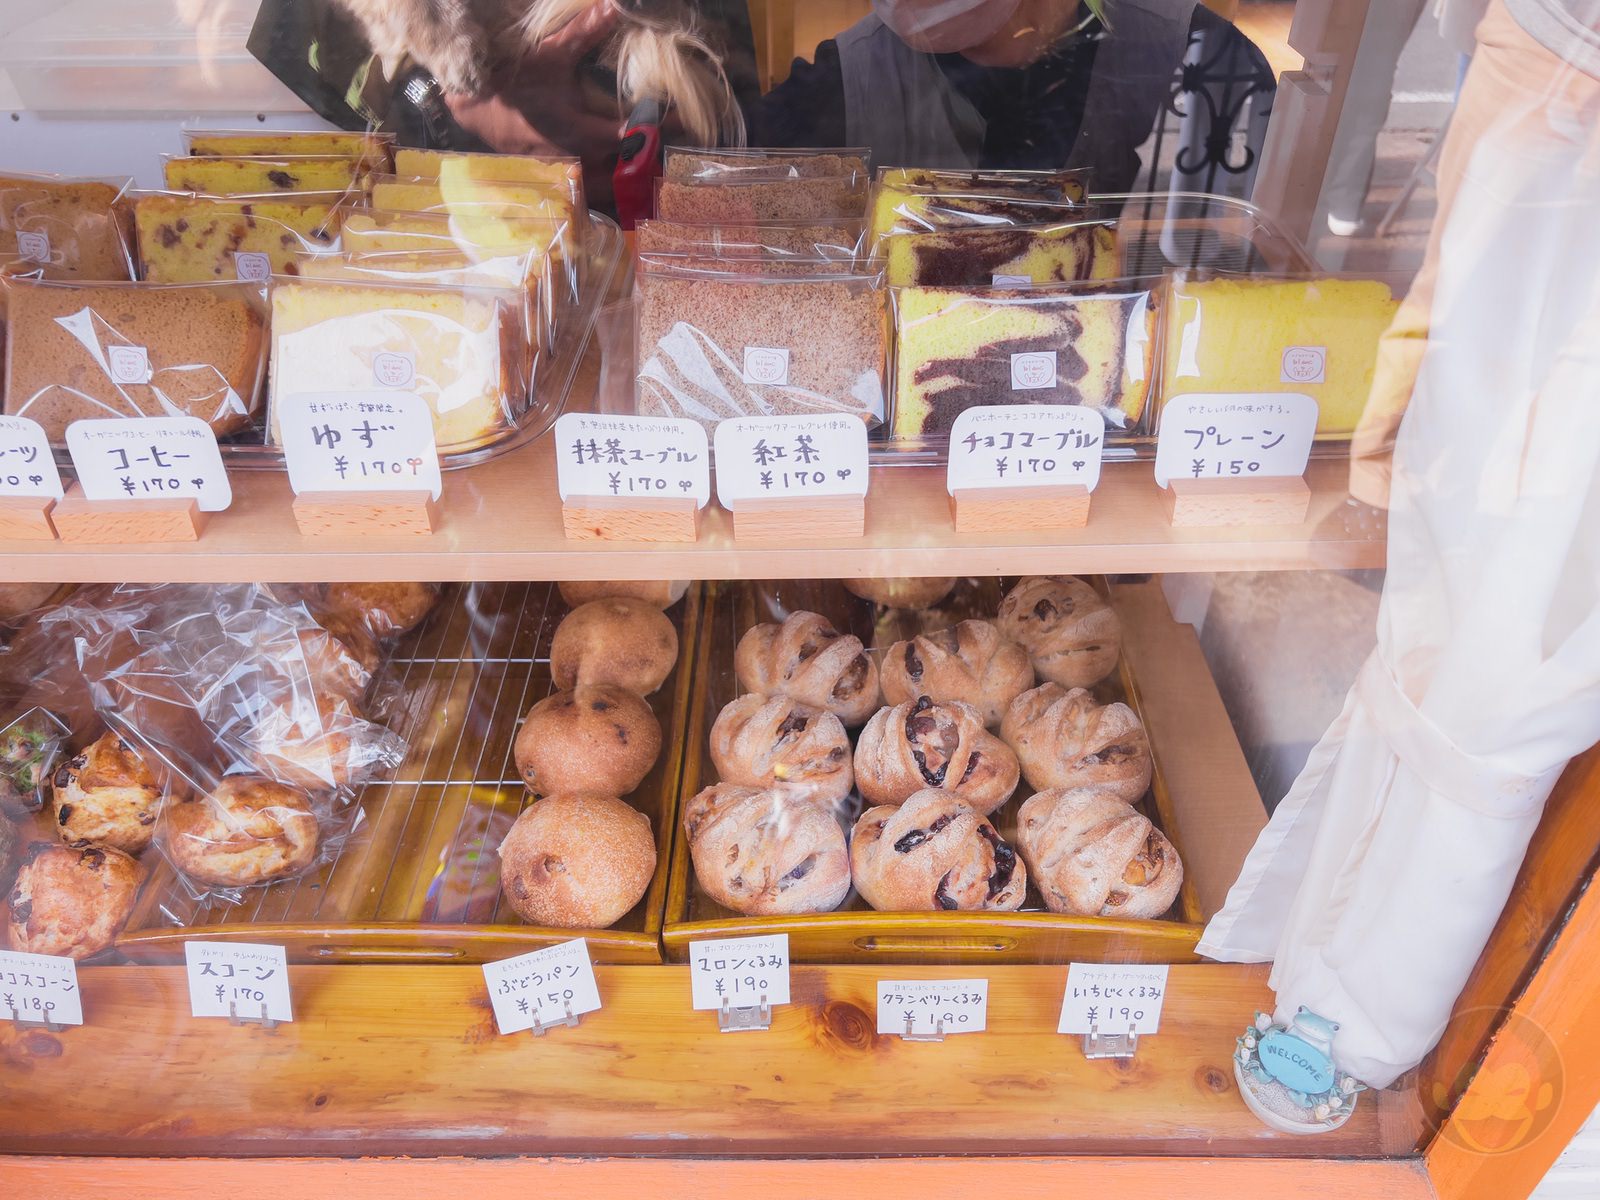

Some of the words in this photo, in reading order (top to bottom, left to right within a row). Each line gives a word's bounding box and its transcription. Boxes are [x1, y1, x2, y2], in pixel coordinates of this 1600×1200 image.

[311, 420, 396, 450] ゆず
[961, 428, 1100, 455] チョコマーブル
[1183, 425, 1286, 450] プレーン
[106, 445, 191, 470] コーヒー
[571, 438, 699, 466] 抹茶マーブル
[752, 434, 821, 467] 紅茶
[334, 455, 403, 480] ¥170
[995, 456, 1057, 478] ¥170
[1191, 458, 1261, 478] ¥150
[120, 476, 181, 496] ¥170
[608, 471, 668, 495] ¥170
[760, 470, 826, 490] ¥170
[197, 961, 275, 980] スコーン
[698, 955, 783, 972] マロンくるみ
[498, 966, 580, 995] ぶどうパン
[715, 976, 768, 996] ¥190
[3, 992, 56, 1010] ¥180
[215, 984, 265, 1003] ¥170
[515, 989, 574, 1015] ¥150
[883, 993, 982, 1006] クランベリーくるみ
[1073, 984, 1161, 1001] いちじくくるみ
[903, 1010, 969, 1024] ¥190
[1087, 1005, 1144, 1025] ¥190
[1266, 1045, 1324, 1082] WELCOME
